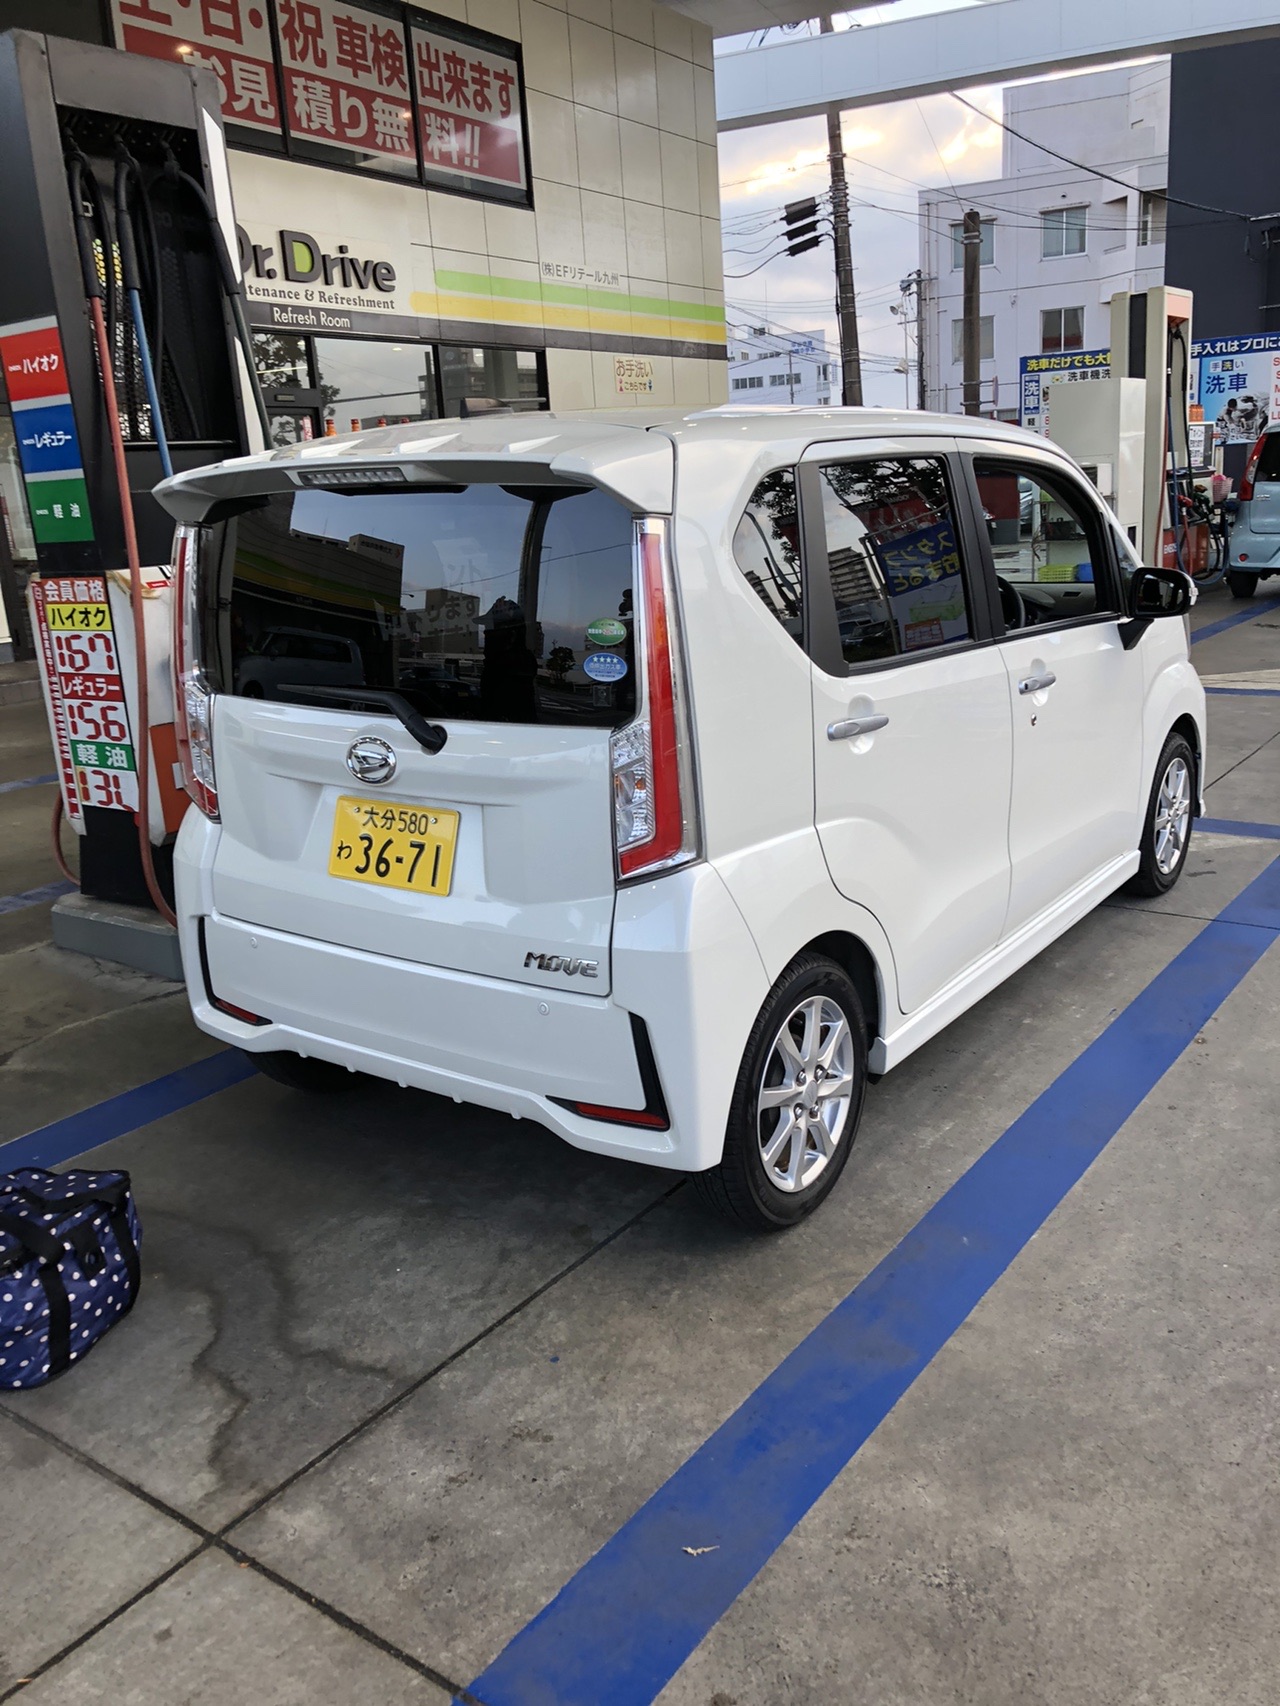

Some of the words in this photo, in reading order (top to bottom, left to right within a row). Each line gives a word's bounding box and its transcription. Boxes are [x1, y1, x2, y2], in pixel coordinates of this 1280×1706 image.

[279, 229, 397, 292] Drive
[304, 288, 314, 301] &
[318, 290, 395, 309] Refreshment
[273, 307, 317, 325] Refresh
[319, 311, 351, 328] Room
[1190, 336, 1280, 357] 手入れはプロに
[22, 353, 59, 374] ハイオク
[616, 359, 653, 378] お手洗い
[1211, 360, 1244, 371] 手洗い
[1024, 381, 1039, 409] 洗車
[1205, 373, 1249, 395] 洗車
[34, 431, 73, 448] レギュラー
[44, 579, 105, 602] 会員価格
[51, 607, 107, 628] ハイオク
[56, 633, 115, 672] 167
[62, 675, 121, 698] レギュラー
[67, 702, 127, 743] 156
[76, 744, 129, 770] 軽油
[336, 840, 353, 860] わ
[354, 833, 442, 888] 36-71
[523, 951, 599, 979] MOVE
